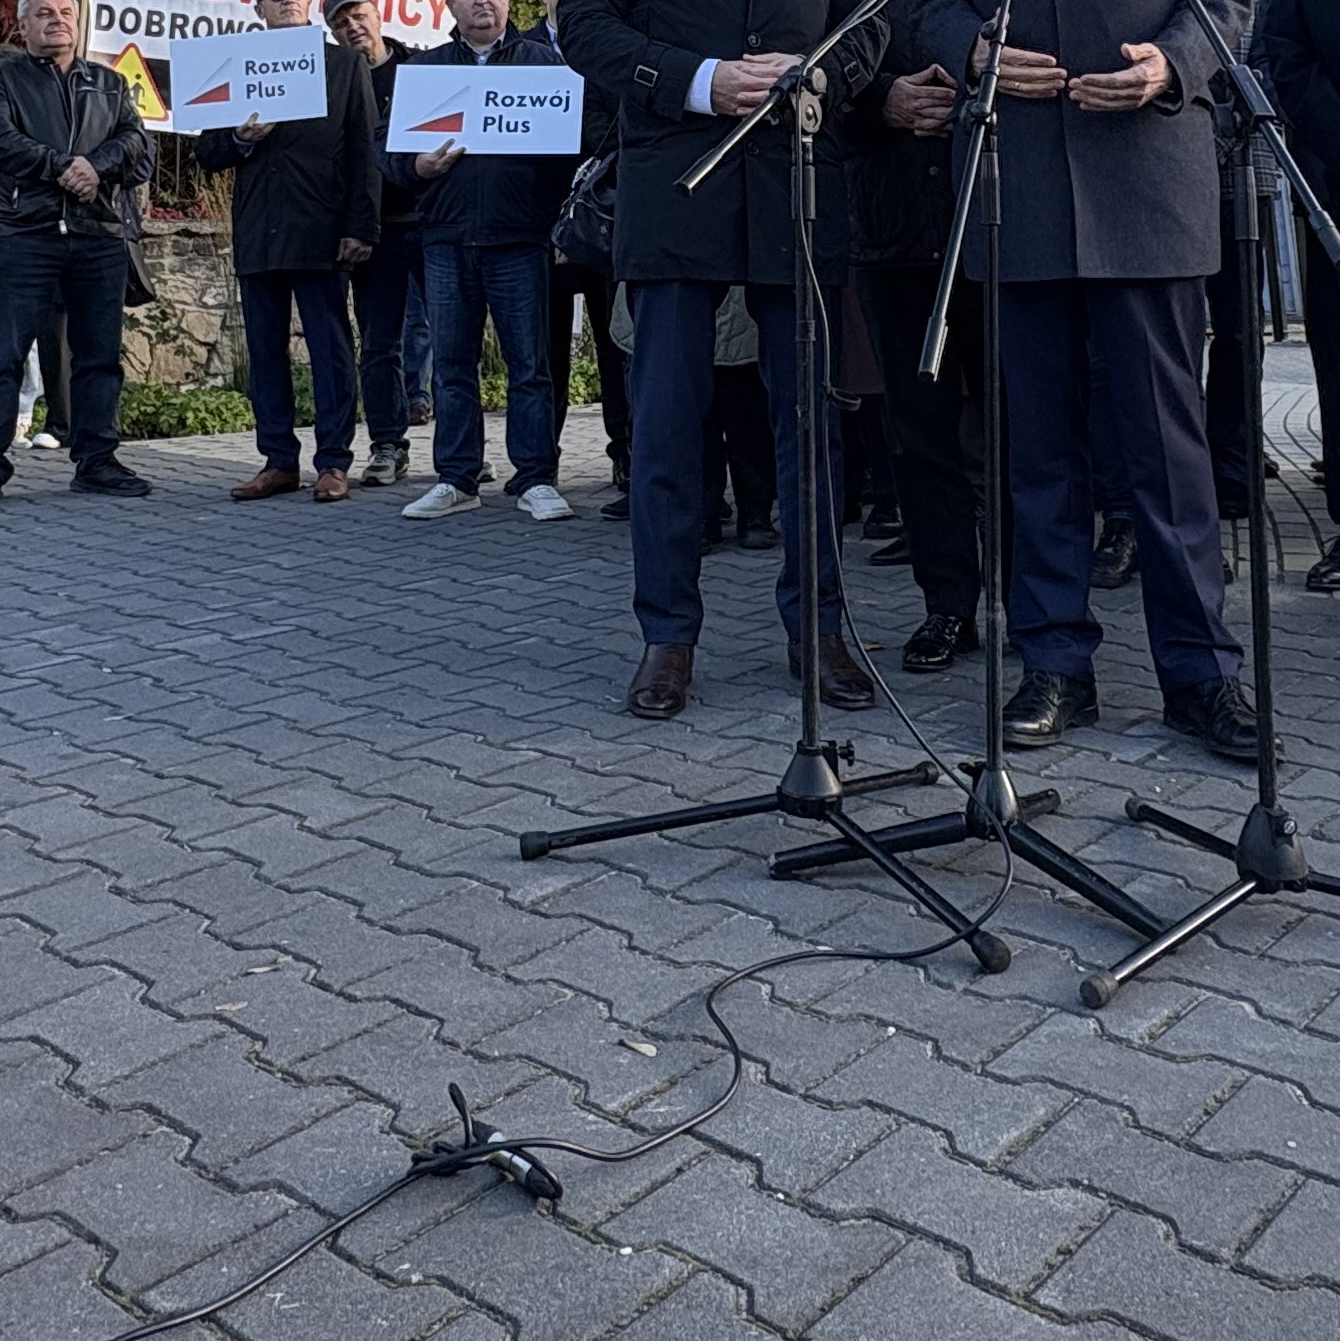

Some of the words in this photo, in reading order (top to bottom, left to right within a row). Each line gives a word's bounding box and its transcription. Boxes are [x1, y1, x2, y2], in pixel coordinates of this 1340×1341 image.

[244, 53, 316, 77] Rozwój
[245, 81, 286, 100] Plus
[484, 90, 571, 115] Rozwój
[482, 116, 531, 134] Plus
